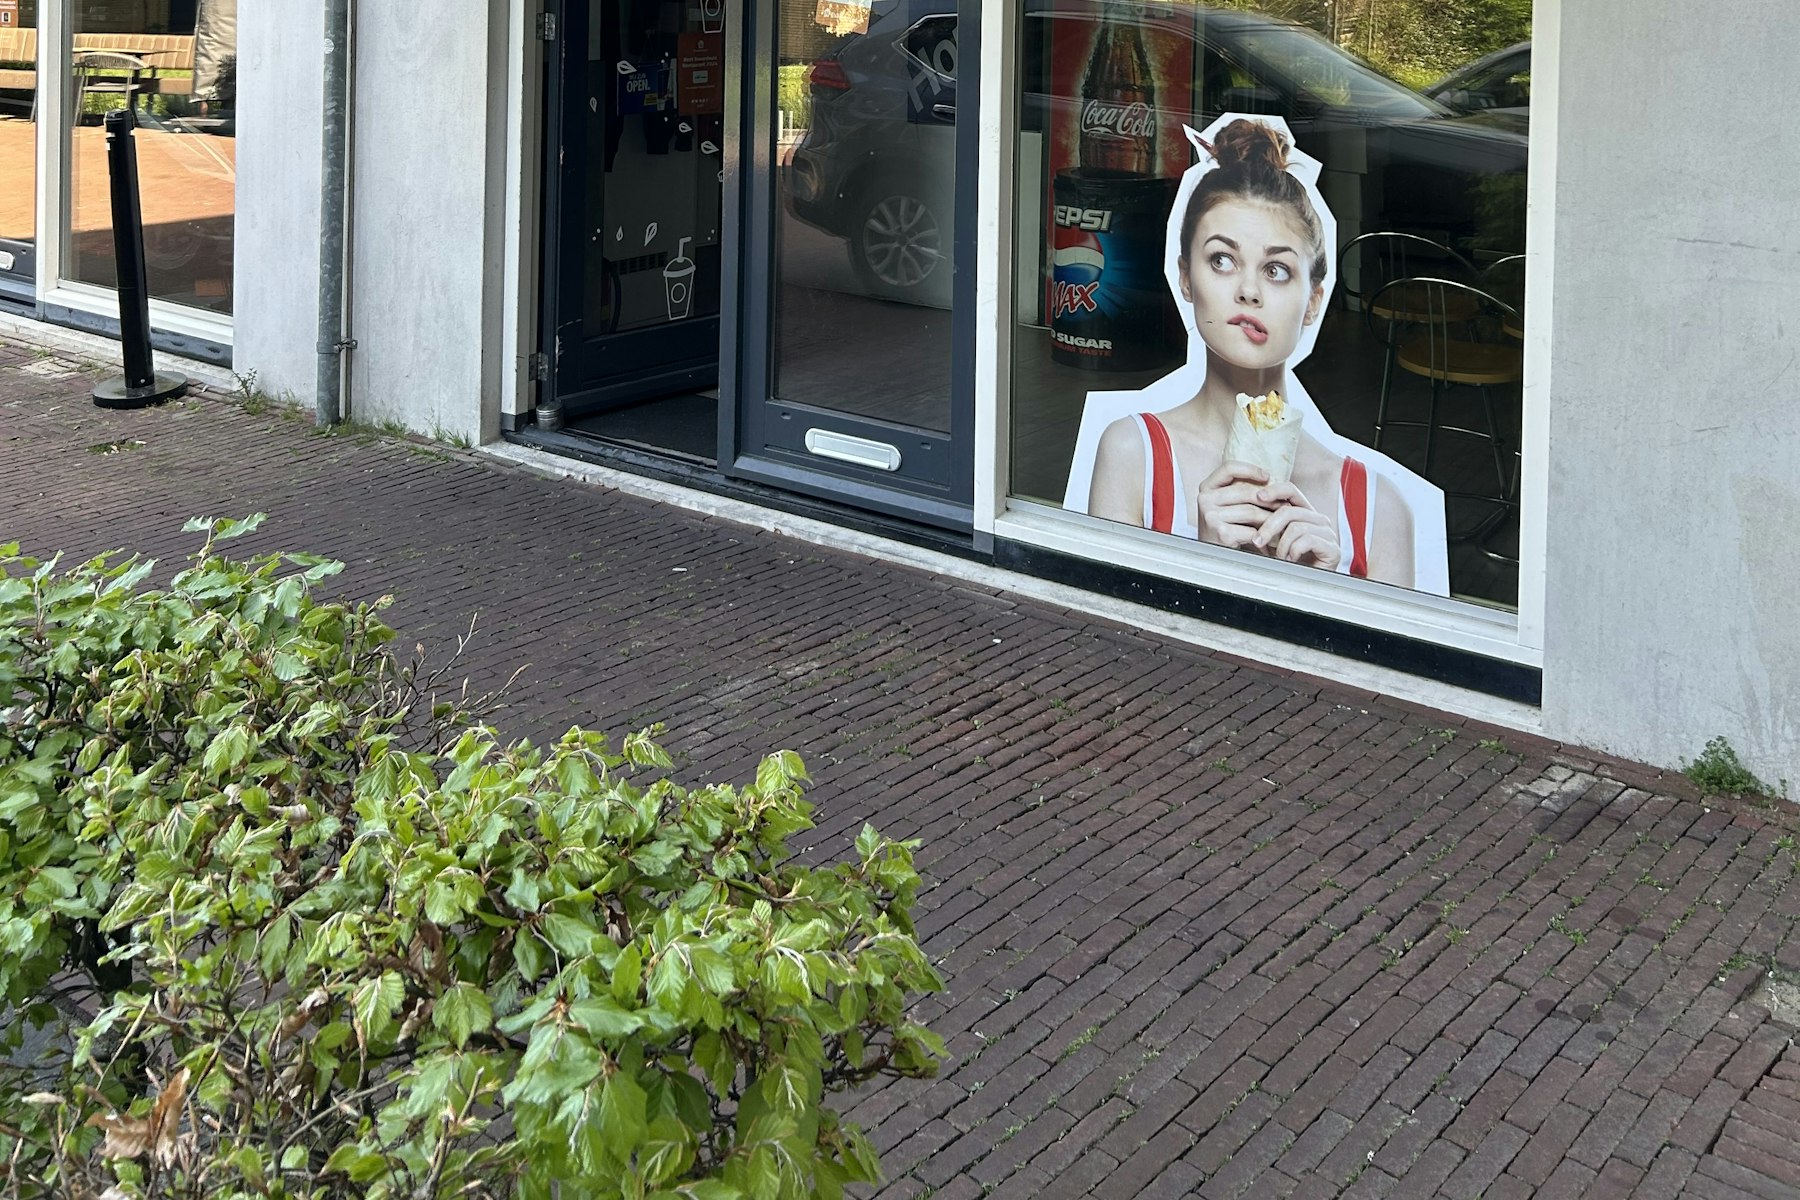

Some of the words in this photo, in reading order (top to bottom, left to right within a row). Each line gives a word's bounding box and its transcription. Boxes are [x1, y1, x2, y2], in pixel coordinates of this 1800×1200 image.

[626, 78, 651, 93] OPEN.
[1053, 205, 1112, 231] EPSI
[1056, 332, 1113, 350] SUGAR
